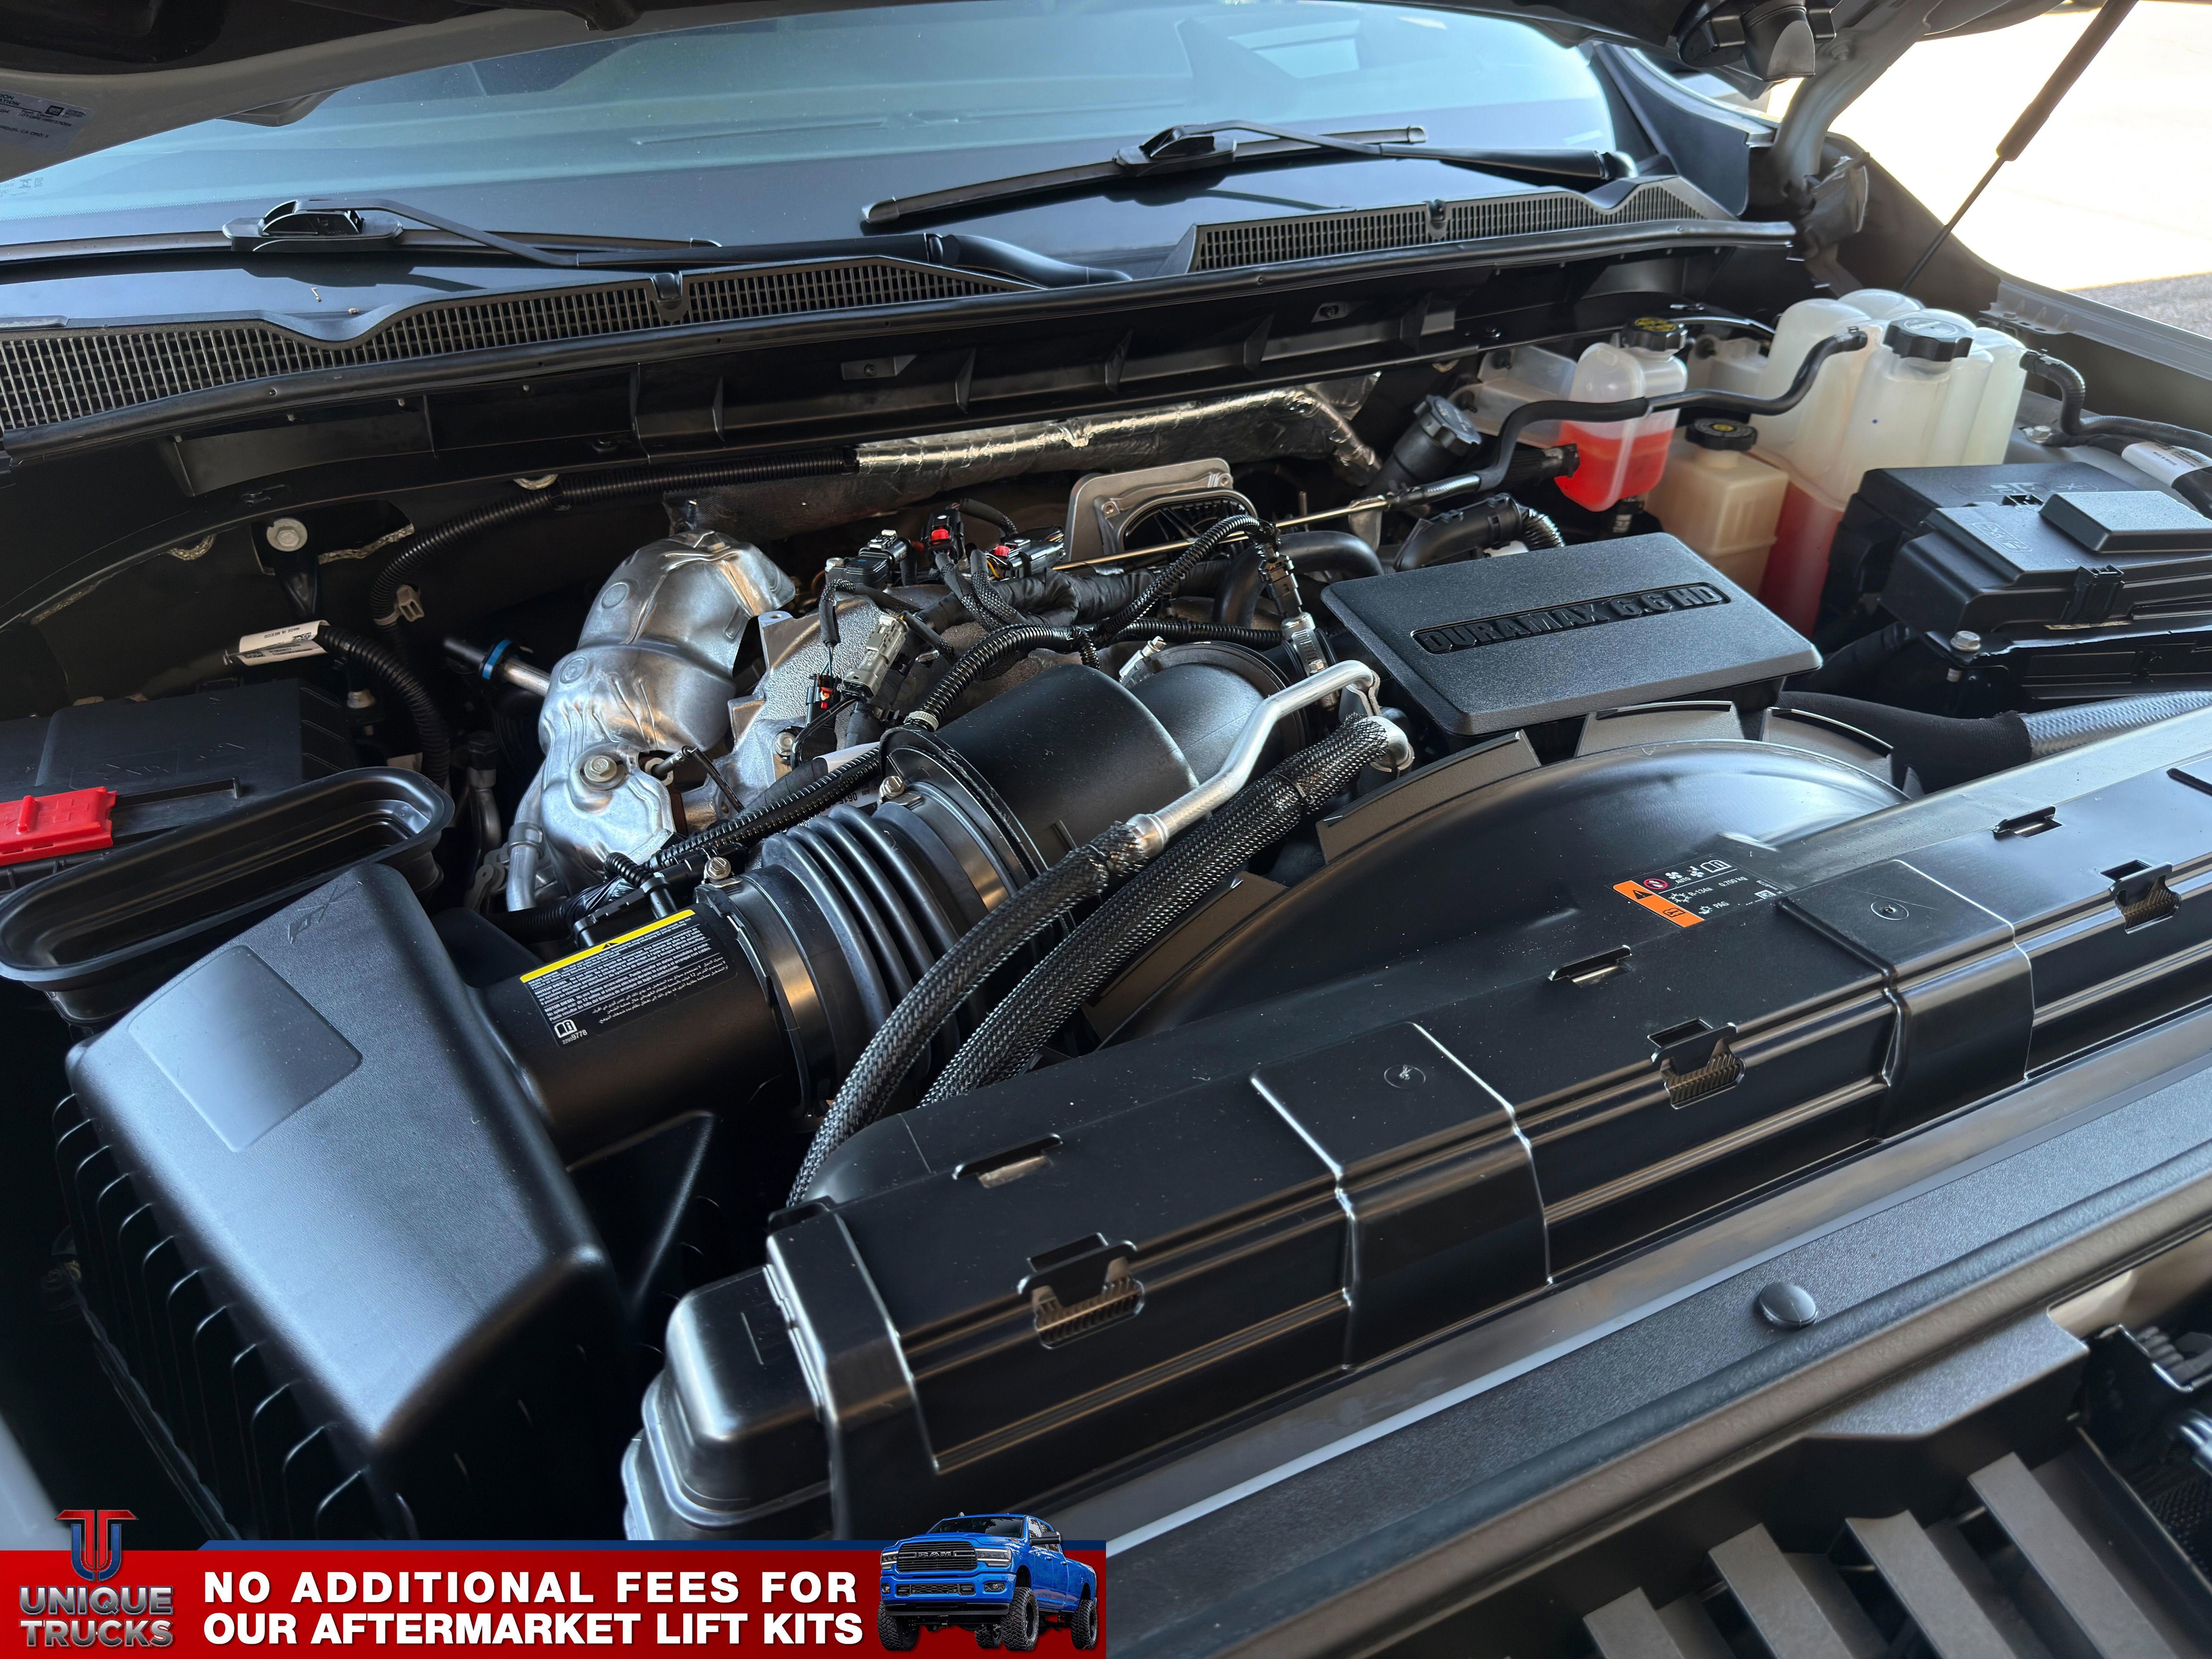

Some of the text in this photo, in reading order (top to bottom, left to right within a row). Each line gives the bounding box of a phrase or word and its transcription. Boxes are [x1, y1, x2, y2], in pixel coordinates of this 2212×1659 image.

[1417, 585, 1725, 652] DURAMAX 6.6 HD
[1688, 887, 1713, 897] R-134a
[1718, 878, 1737, 887] 0.700
[1712, 901, 1729, 909] PAG
[534, 985, 553, 995] MOTEUR
[552, 979, 568, 988] DIESEL
[544, 1003, 560, 1012] MOTOR
[560, 997, 576, 1006] DIESEL
